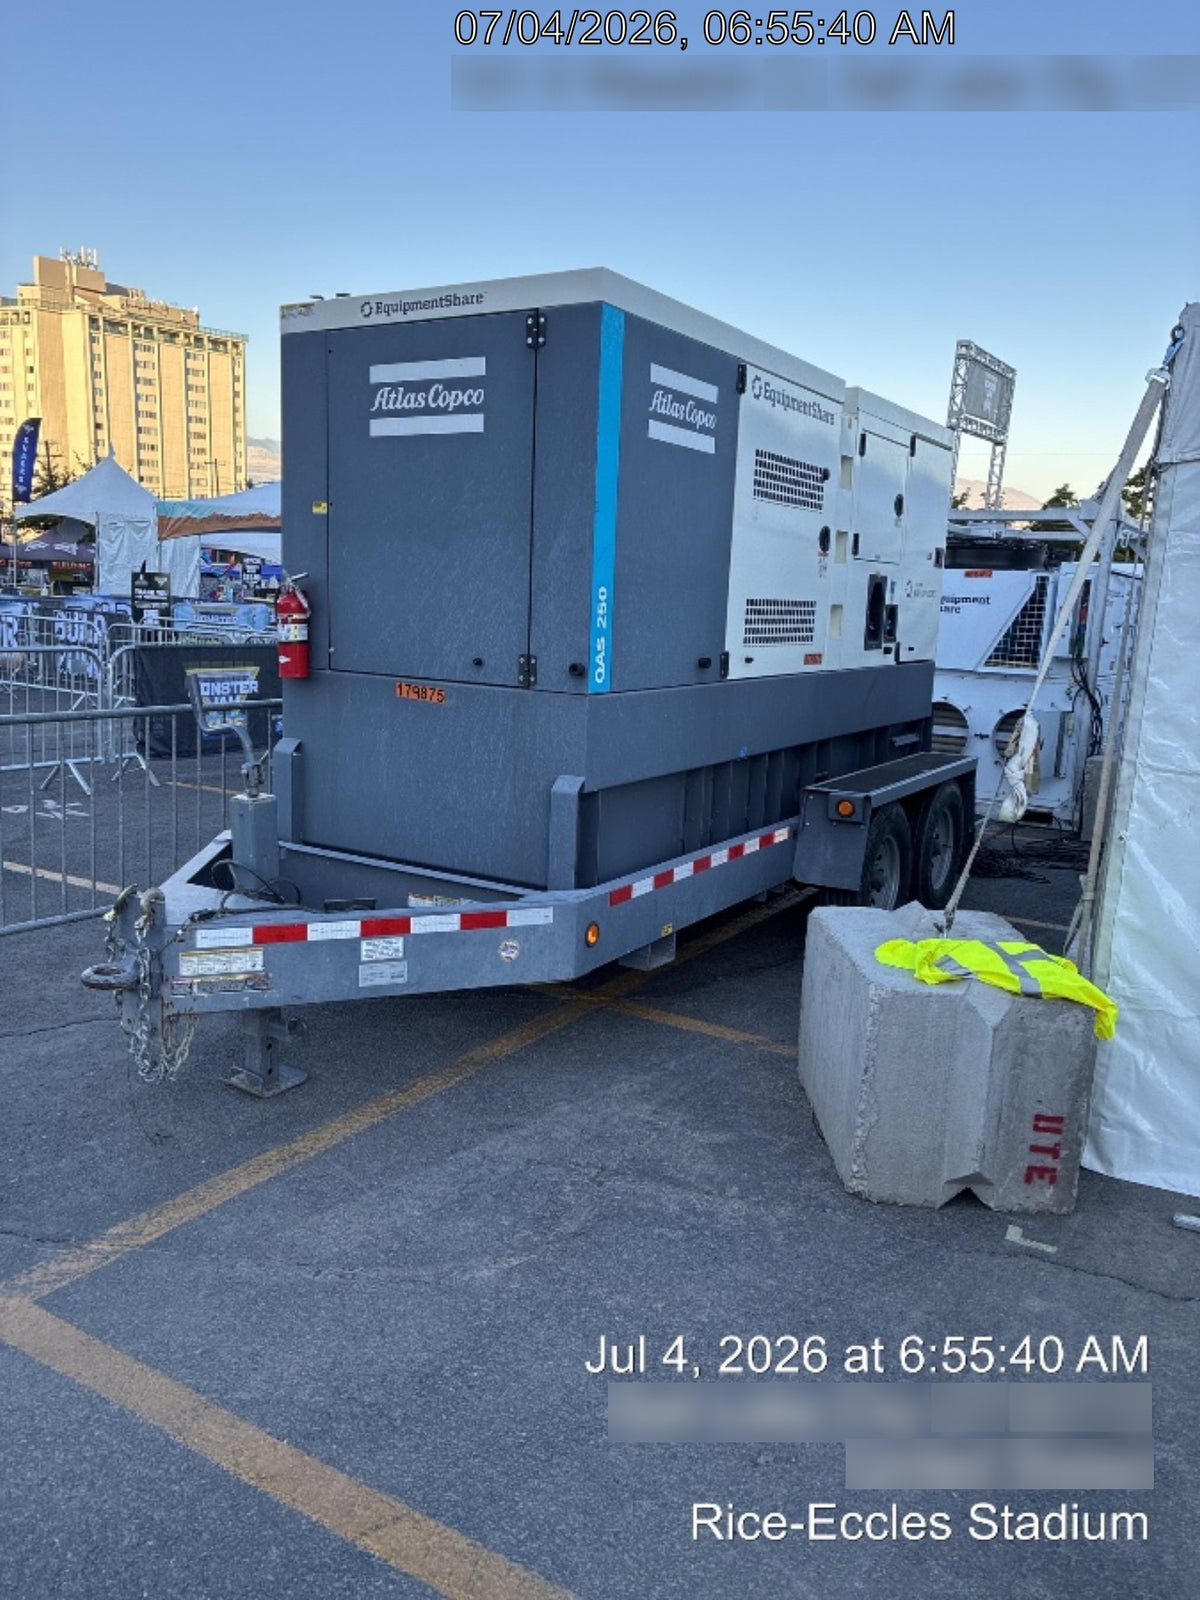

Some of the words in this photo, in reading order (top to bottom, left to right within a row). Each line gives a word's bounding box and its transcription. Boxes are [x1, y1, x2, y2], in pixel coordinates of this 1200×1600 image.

[374, 292, 485, 316] EquipmentShare
[370, 386, 426, 412] Atlas
[427, 384, 485, 412] Copco
[649, 390, 689, 421] Atlas
[685, 399, 717, 430] Copco
[763, 381, 836, 426] EquipmentShare
[596, 585, 608, 629] 250
[594, 636, 606, 684] QAS
[200, 680, 259, 696] ONSTER
[397, 682, 445, 704] 179875
